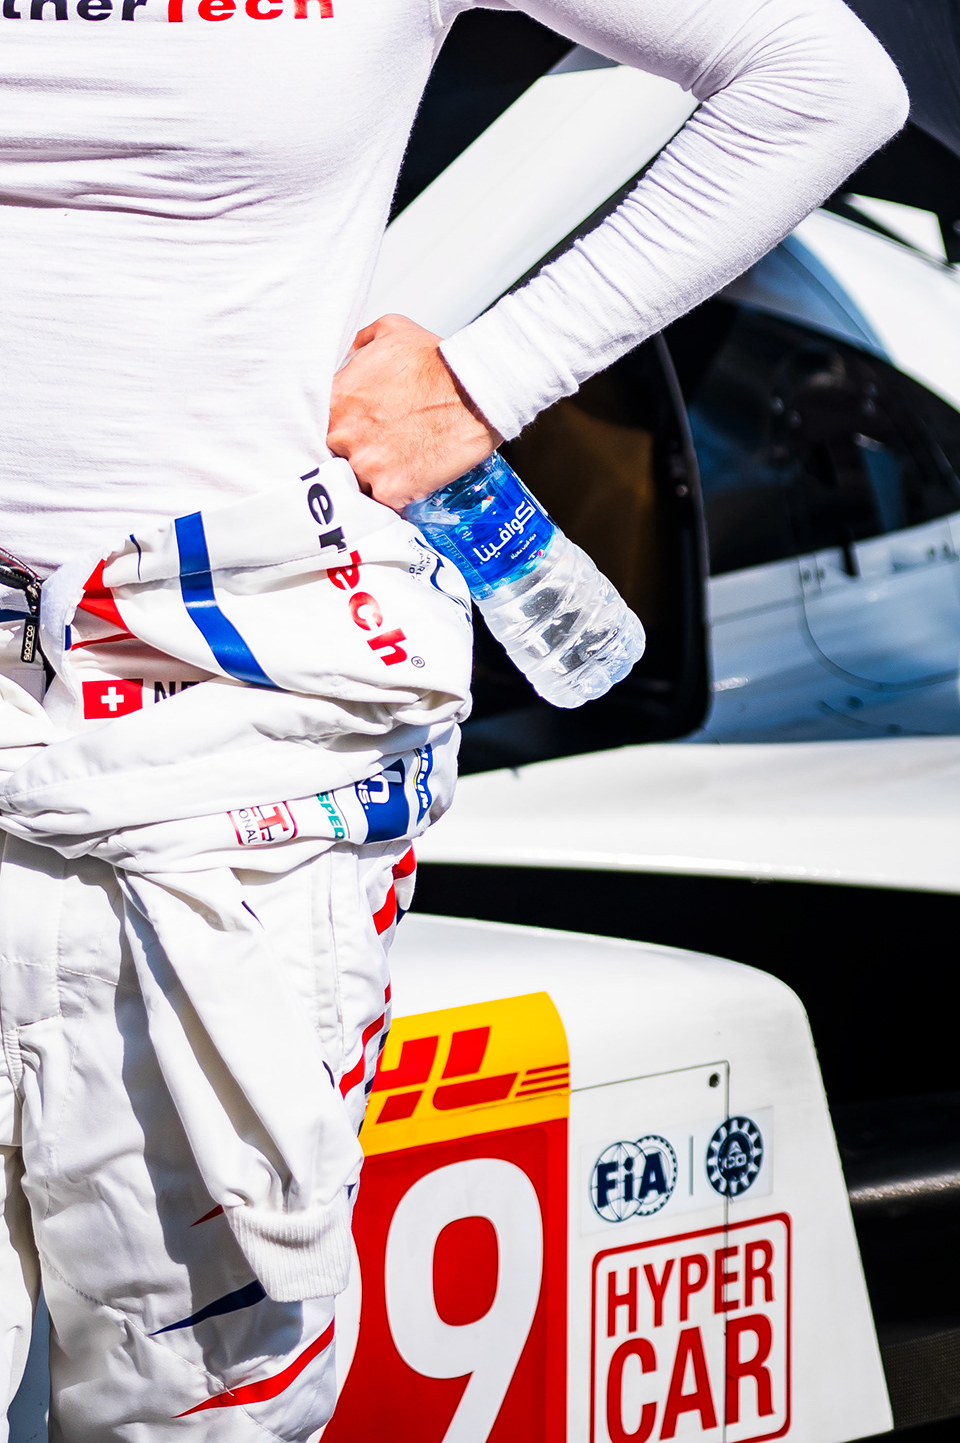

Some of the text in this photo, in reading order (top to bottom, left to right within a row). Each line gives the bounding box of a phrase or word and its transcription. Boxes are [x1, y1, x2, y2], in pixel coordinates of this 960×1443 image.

[22, 624, 36, 662] sparco
[238, 808, 259, 843] ONAL
[373, 1025, 519, 1125] HL
[330, 1157, 544, 1443] 9
[606, 1238, 776, 1338] HYPER
[605, 1313, 777, 1443] CAR
